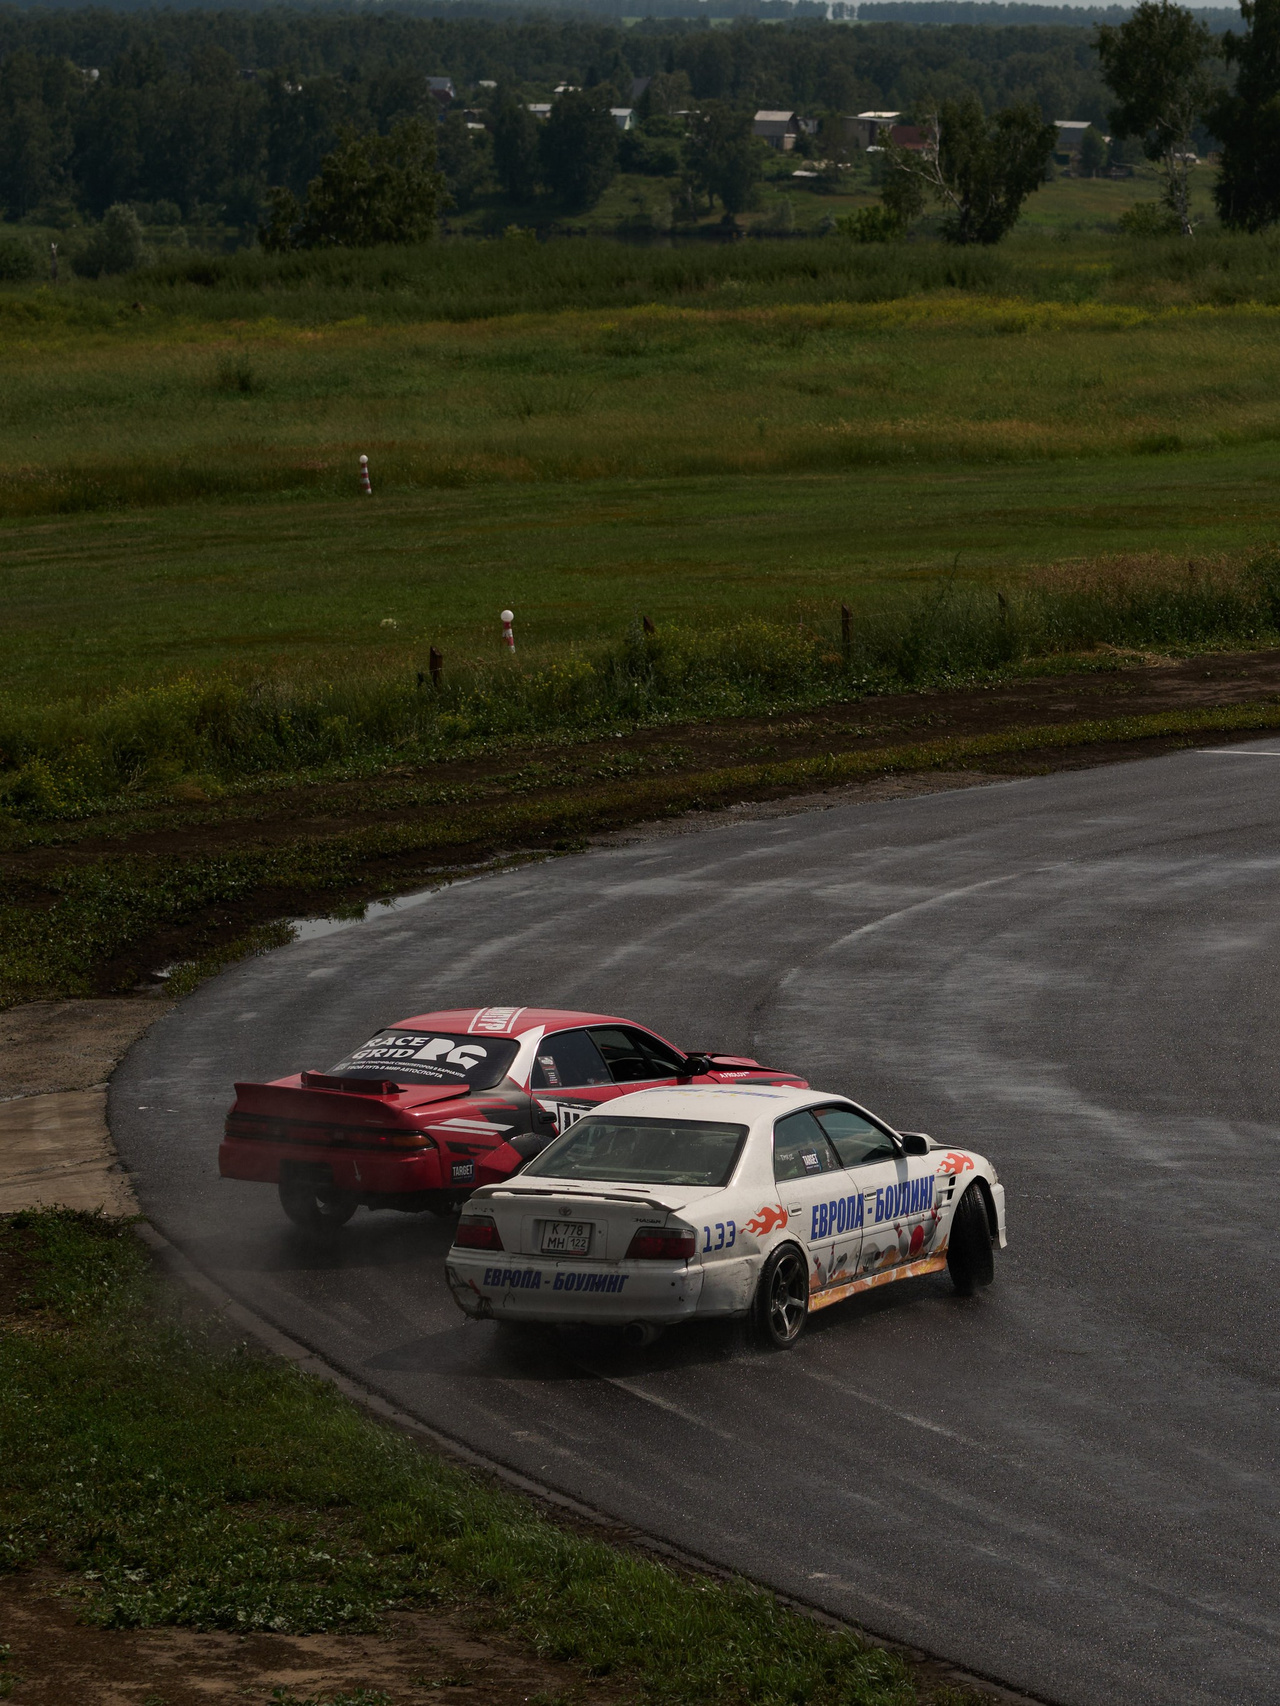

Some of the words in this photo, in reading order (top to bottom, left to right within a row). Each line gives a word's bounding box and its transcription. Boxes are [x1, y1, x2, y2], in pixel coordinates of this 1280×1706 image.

[361, 1037, 430, 1048] RACE
[352, 1048, 415, 1060] GRID
[400, 1066, 443, 1079] АВТОСПОРТА
[802, 1153, 819, 1166] TARGET
[452, 1164, 473, 1177] TARGET
[811, 1193, 864, 1240] ЕВРОПА
[875, 1175, 934, 1223] БОУЛИНГ
[552, 1223, 560, 1235] К
[563, 1223, 584, 1236] 778
[547, 1236, 565, 1249] МН
[570, 1238, 586, 1248] 122
[702, 1220, 736, 1253] 133
[483, 1268, 542, 1289] ЕВРОПА
[552, 1272, 629, 1293] БОУЛИНГ
